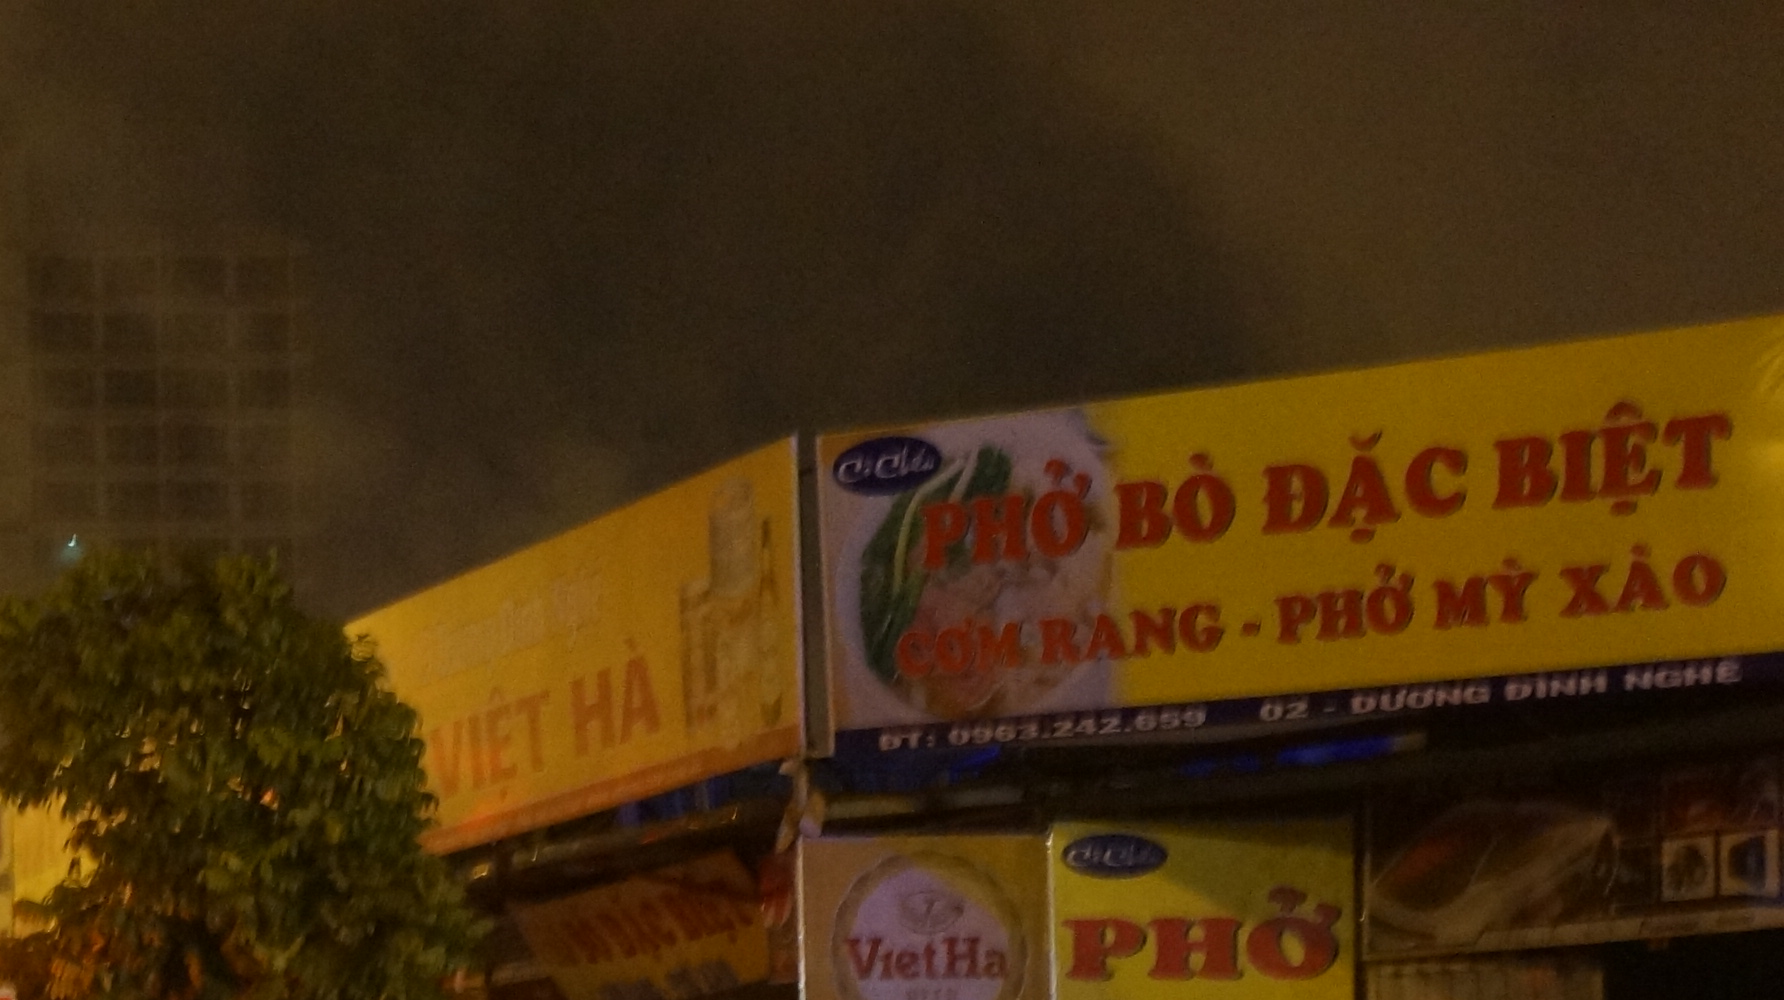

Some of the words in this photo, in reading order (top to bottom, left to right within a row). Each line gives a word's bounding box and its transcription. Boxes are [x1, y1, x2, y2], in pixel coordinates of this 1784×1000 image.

[920, 458, 1093, 571] PHỞ
[1112, 453, 1237, 552] BÒ
[1261, 430, 1469, 544] ĐẶC
[1491, 400, 1734, 518] BIỆT
[895, 616, 1023, 678] CƠM
[1038, 603, 1225, 667] RANG
[1274, 562, 1415, 645] PHỞ
[1558, 543, 1728, 619] XÀO
[427, 686, 551, 802] VIỆT
[568, 637, 663, 757] HÀ
[1061, 885, 1343, 983] PHỞ
